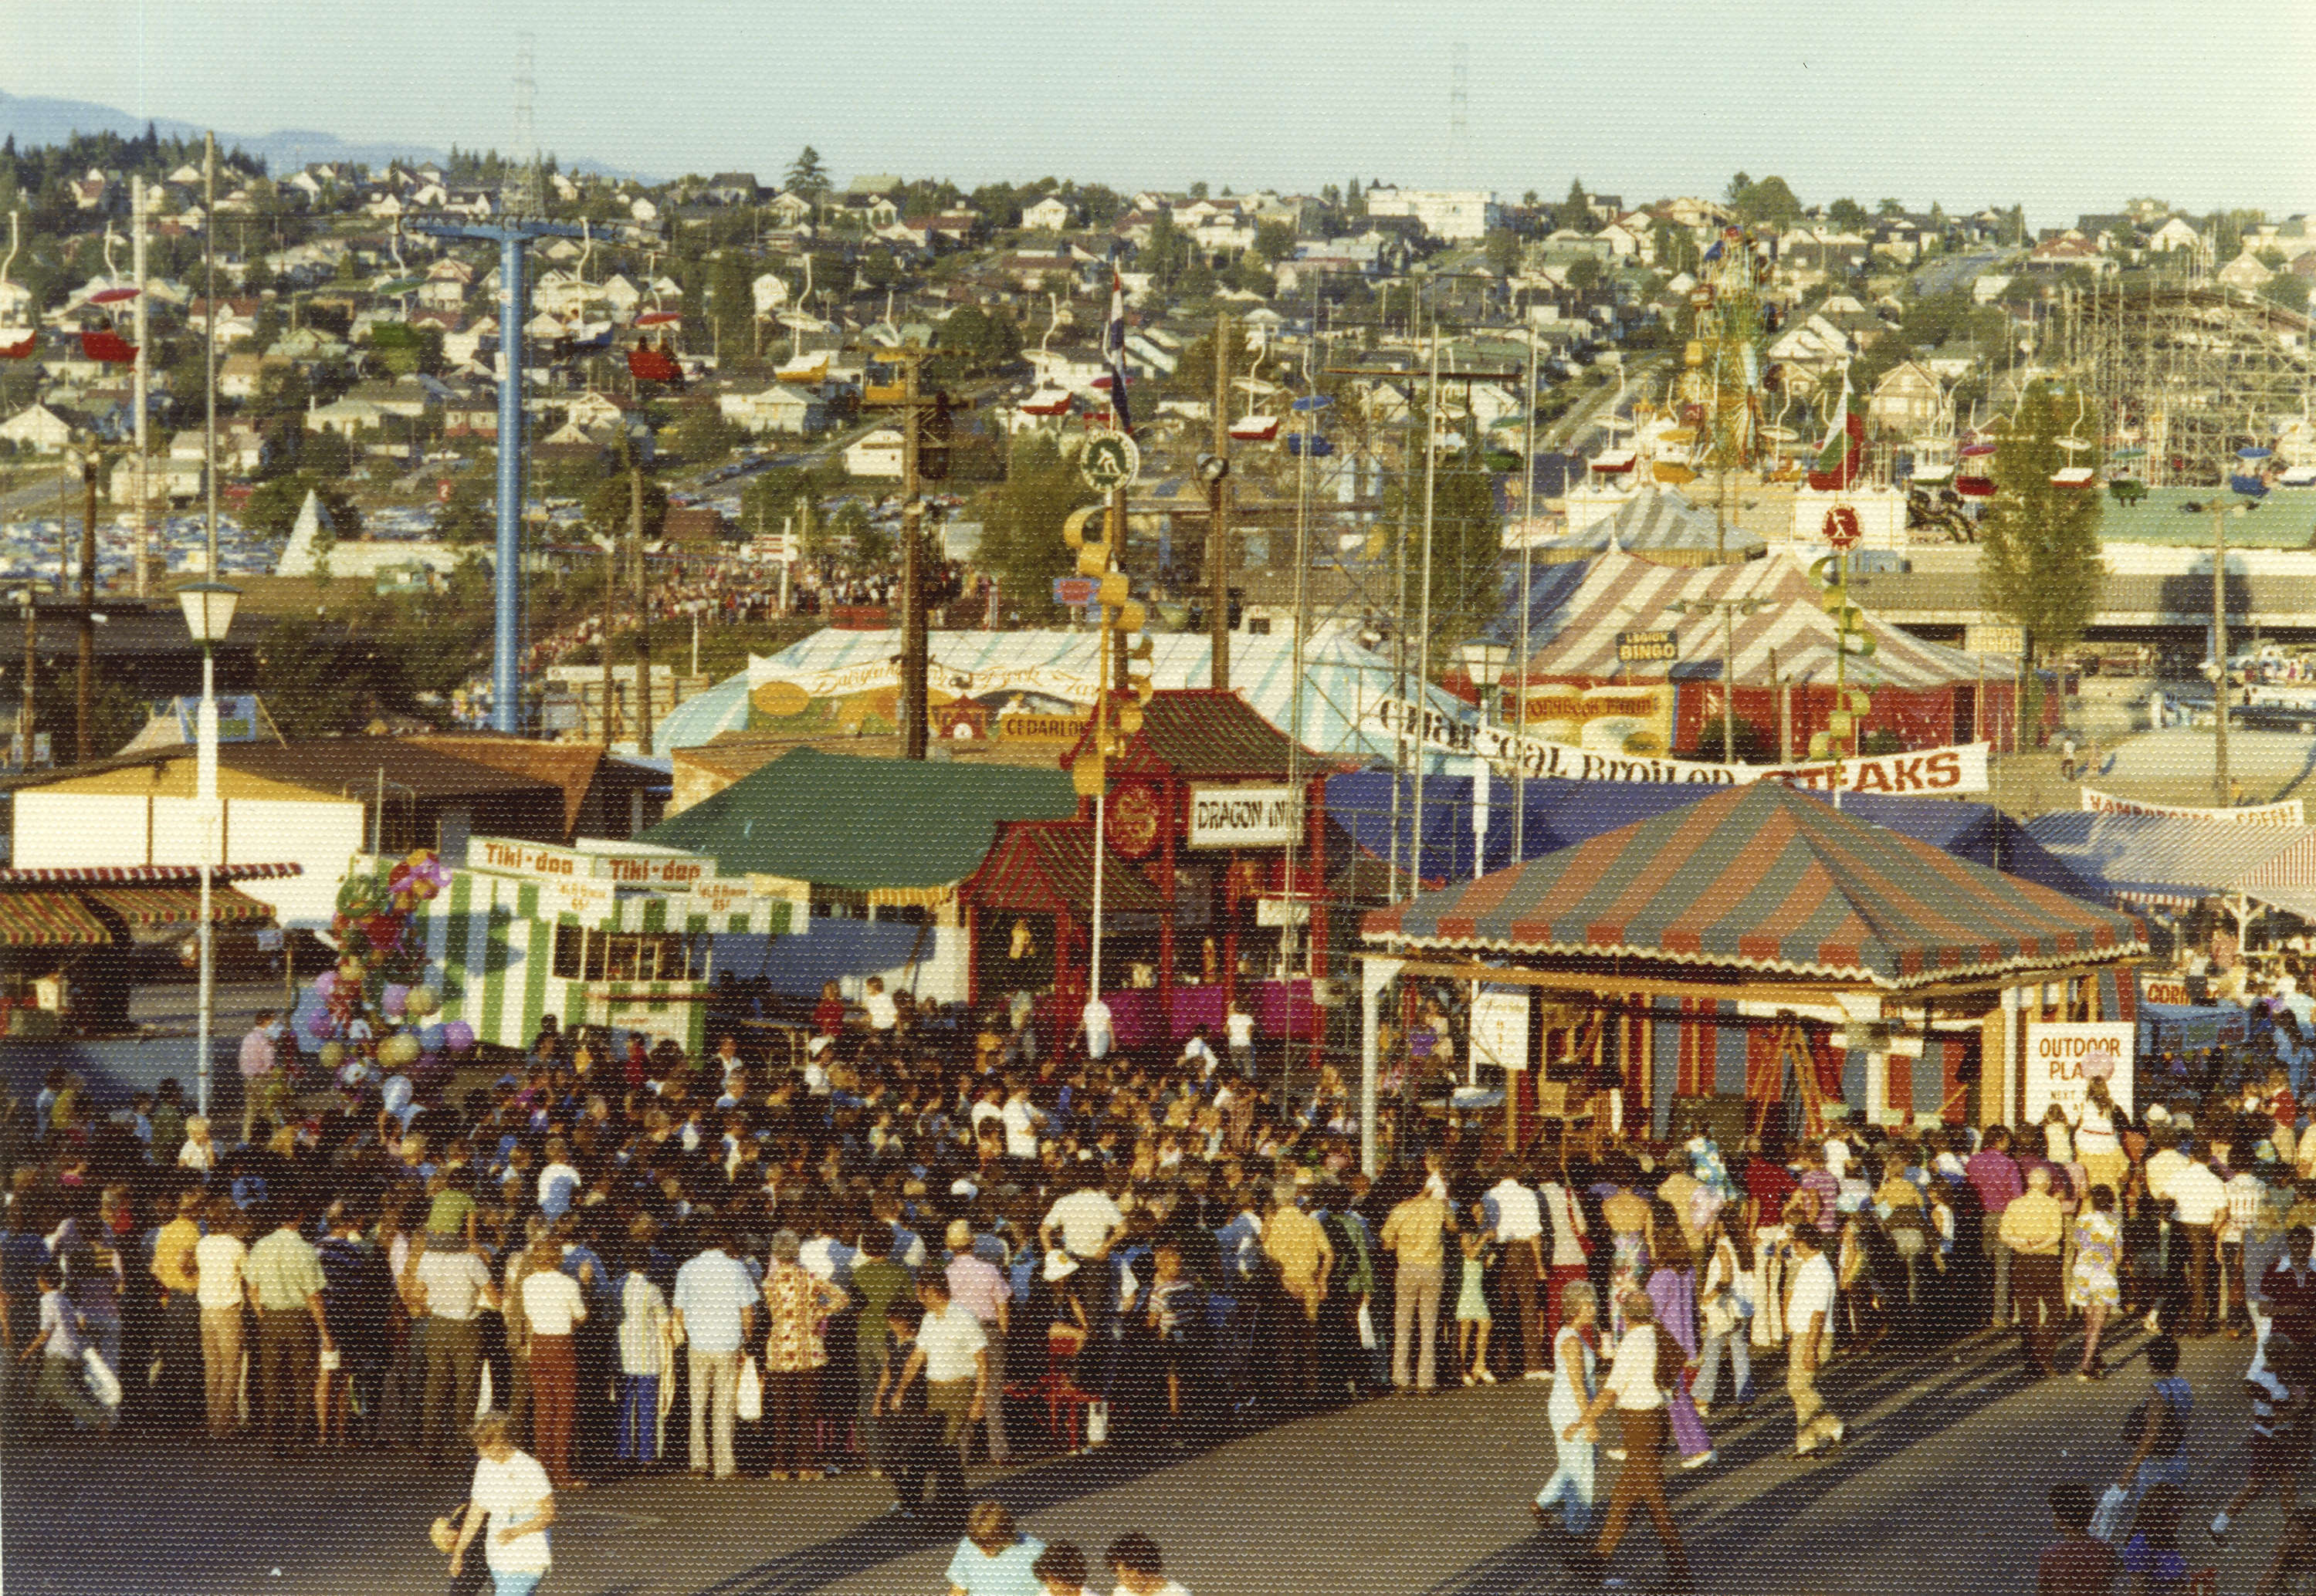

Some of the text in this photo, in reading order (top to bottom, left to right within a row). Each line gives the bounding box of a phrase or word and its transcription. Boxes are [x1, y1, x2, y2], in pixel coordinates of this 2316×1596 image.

[1620, 643, 1675, 661] BINGO
[1006, 719, 1083, 738] CEDARLO
[1762, 752, 1961, 793] STEAKS
[1198, 800, 1263, 830] DRAGON
[2039, 1037, 2121, 1058] OUTDOOR
[2050, 1060, 2084, 1080] PLA
